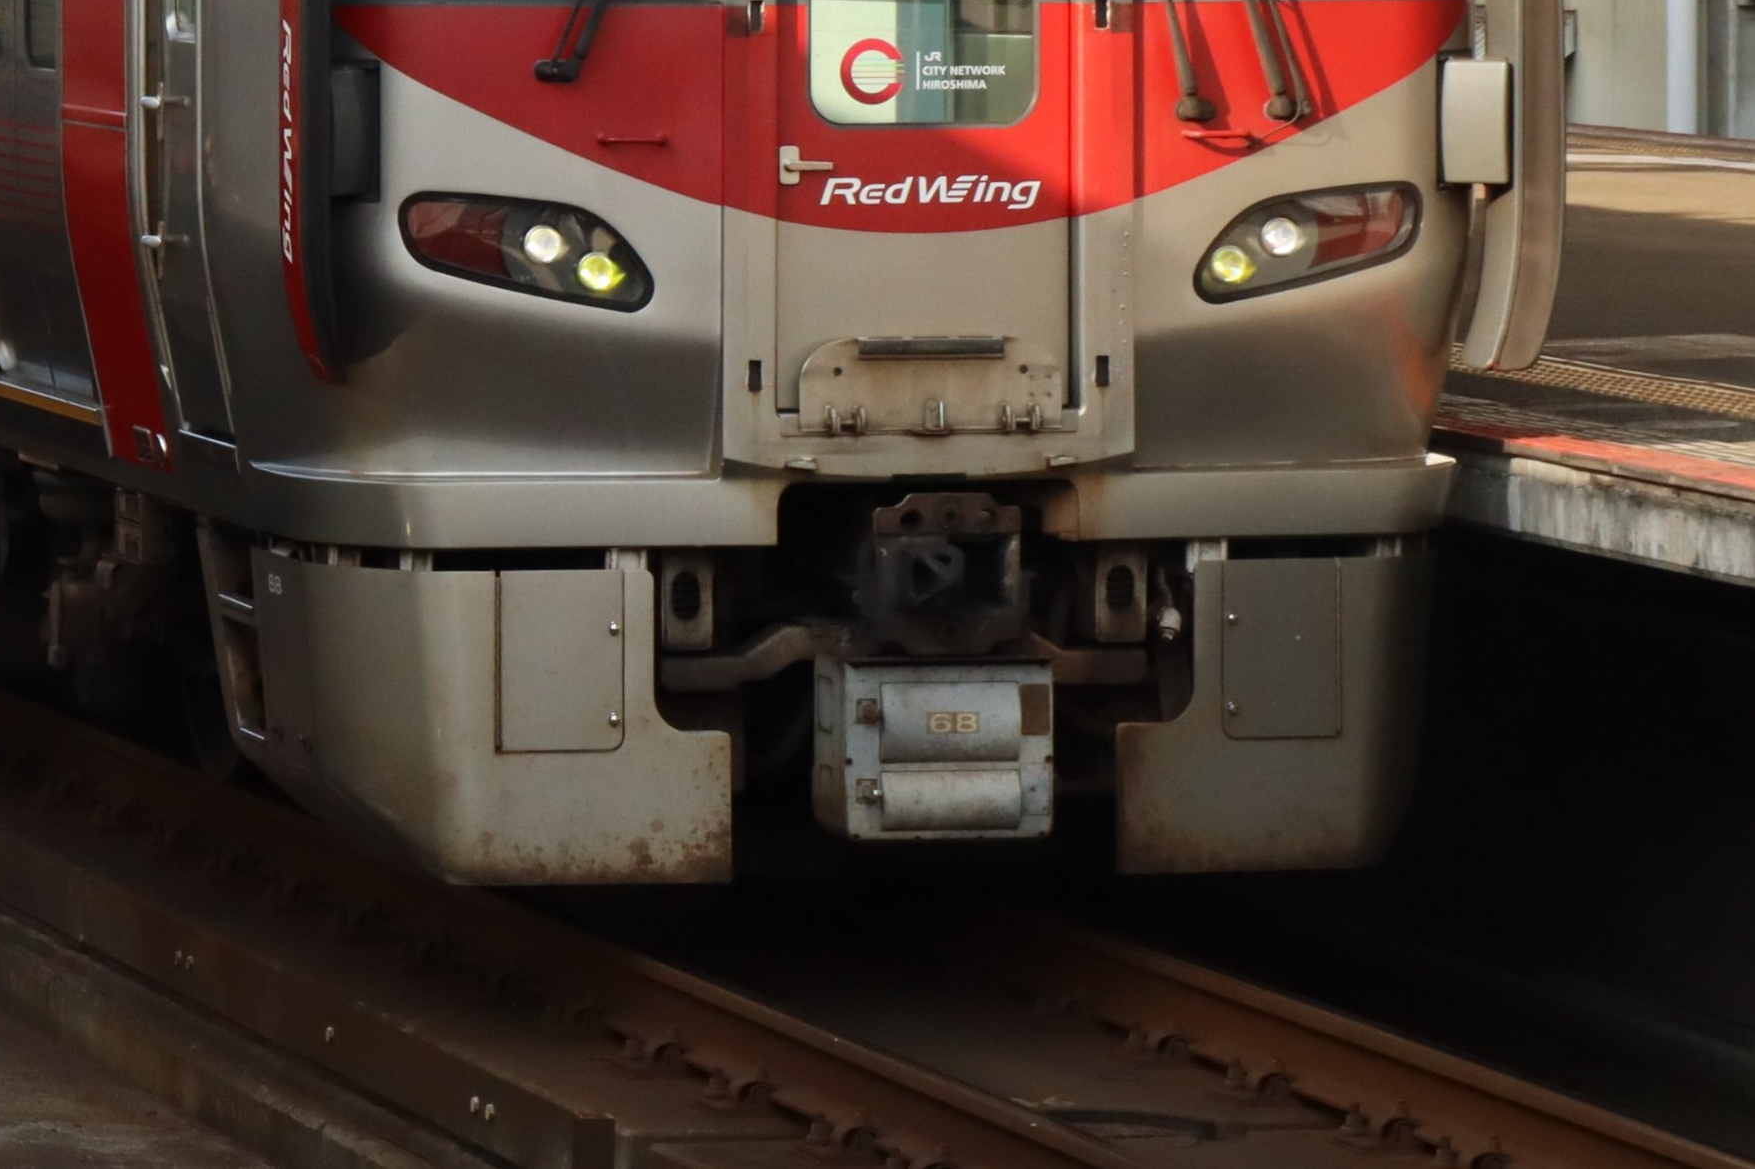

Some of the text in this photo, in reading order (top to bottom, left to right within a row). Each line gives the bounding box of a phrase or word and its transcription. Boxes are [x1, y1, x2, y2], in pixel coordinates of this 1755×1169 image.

[924, 51, 941, 62] JR
[922, 65, 1006, 76] CITY NETWORK
[922, 79, 987, 90] HIROSHIMA
[929, 713, 978, 732] 68
